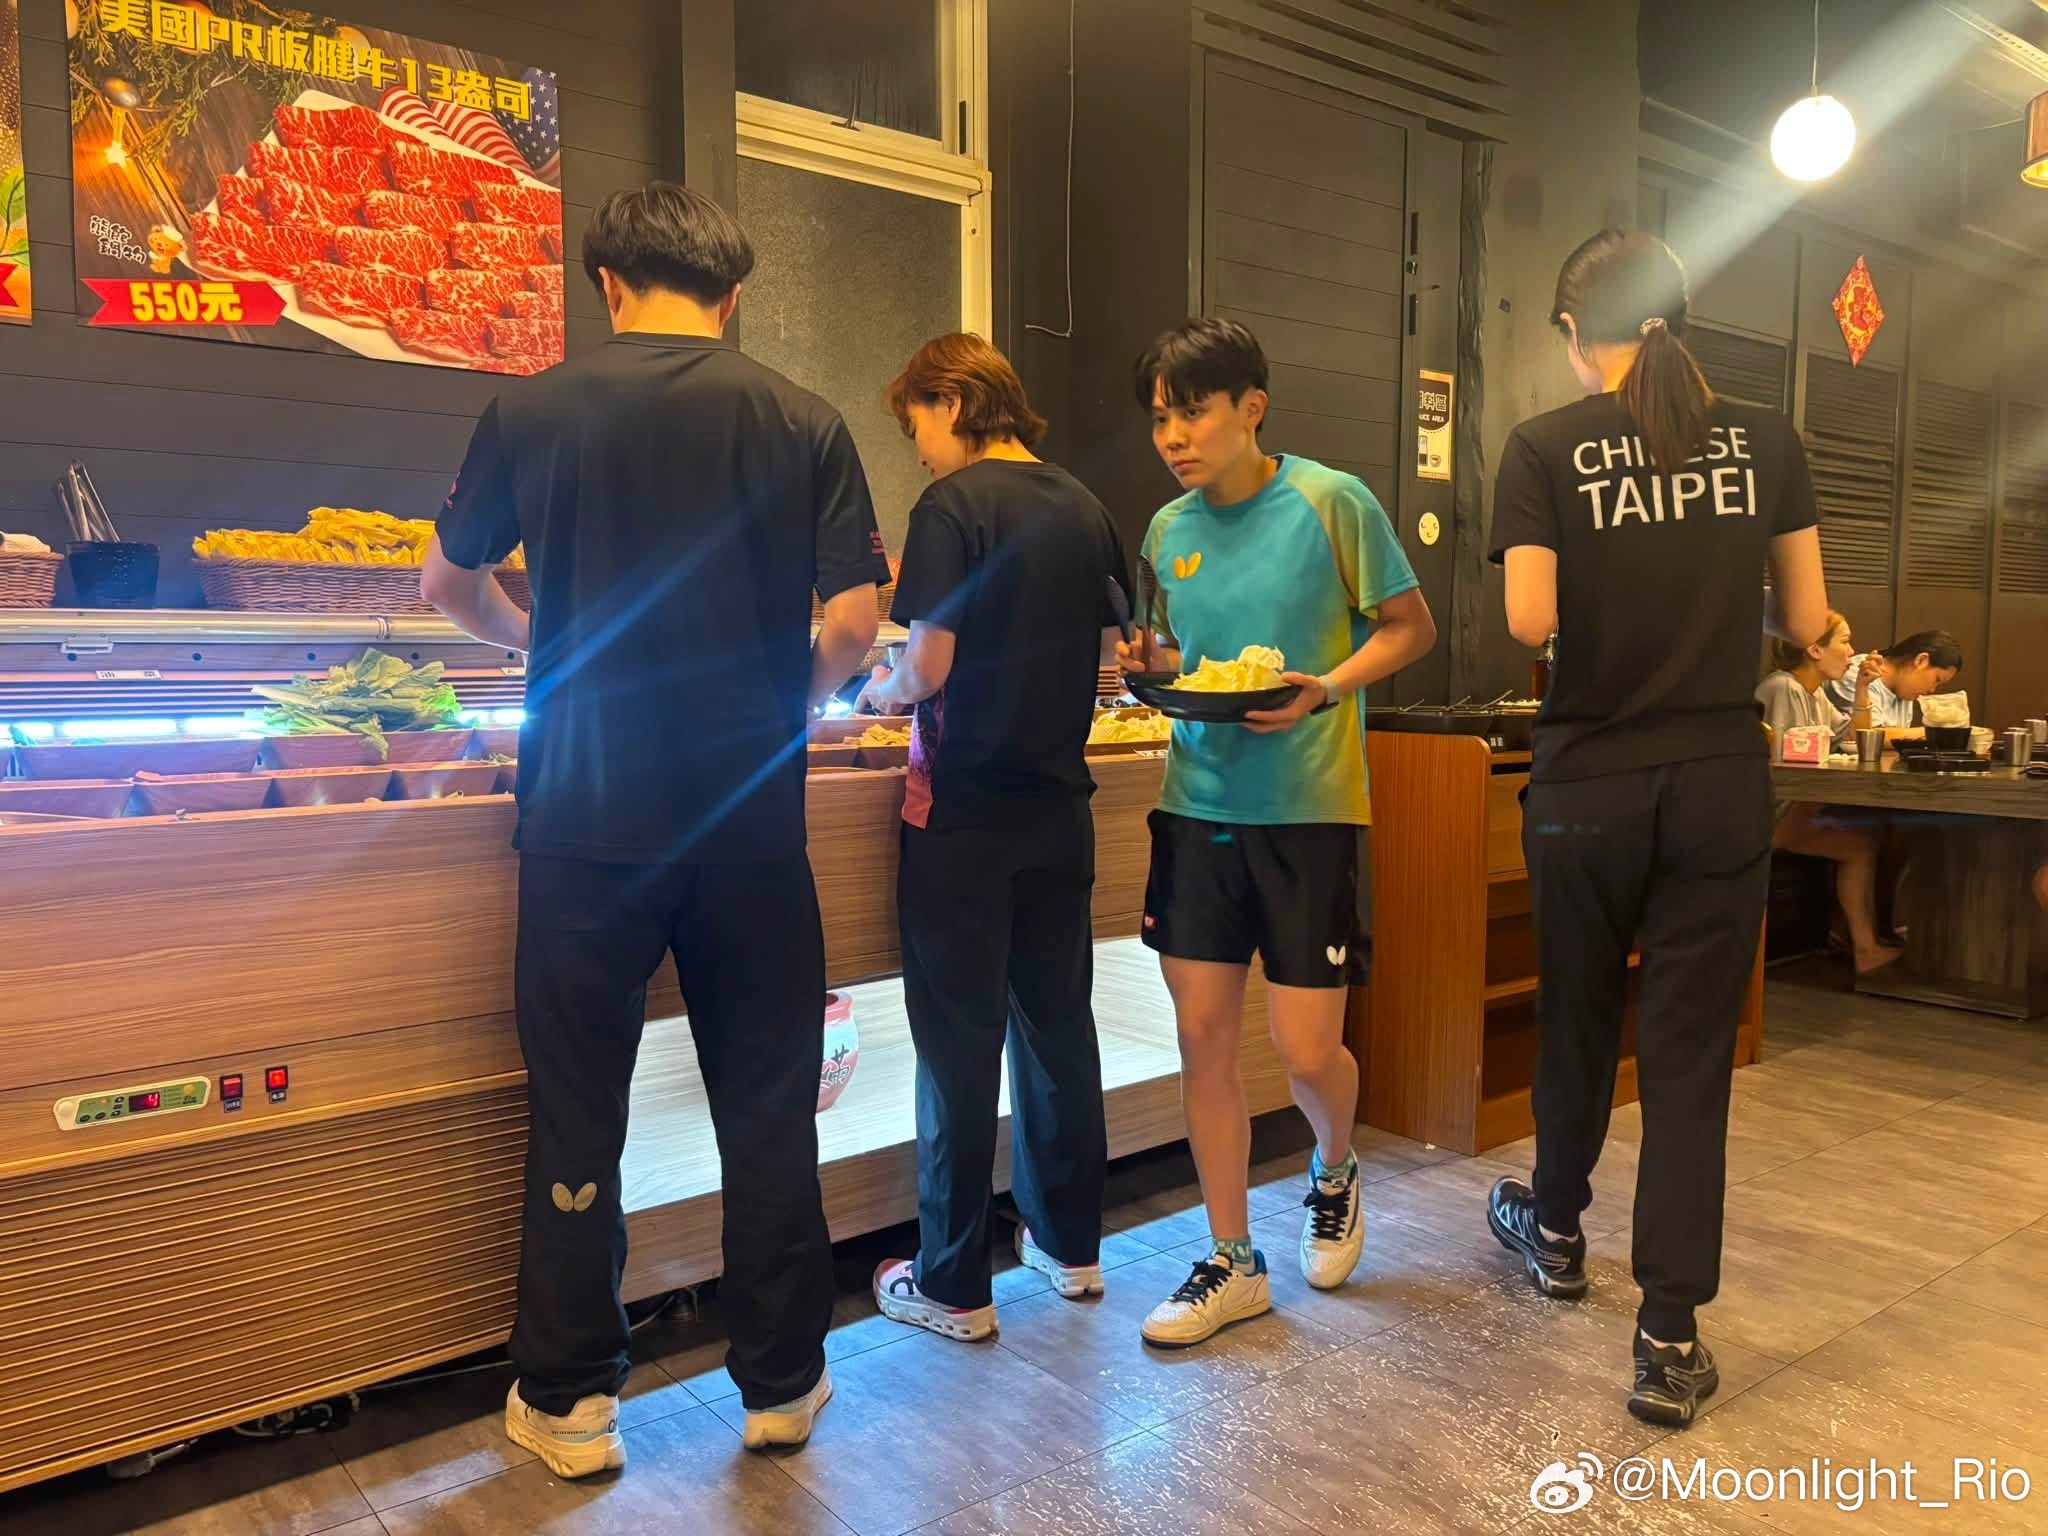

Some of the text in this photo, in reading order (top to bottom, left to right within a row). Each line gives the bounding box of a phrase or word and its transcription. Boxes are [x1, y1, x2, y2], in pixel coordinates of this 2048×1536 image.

[129, 281, 244, 323] 550元
[1573, 427, 1751, 475] CHISE
[1577, 467, 1757, 530] TAIPEI
